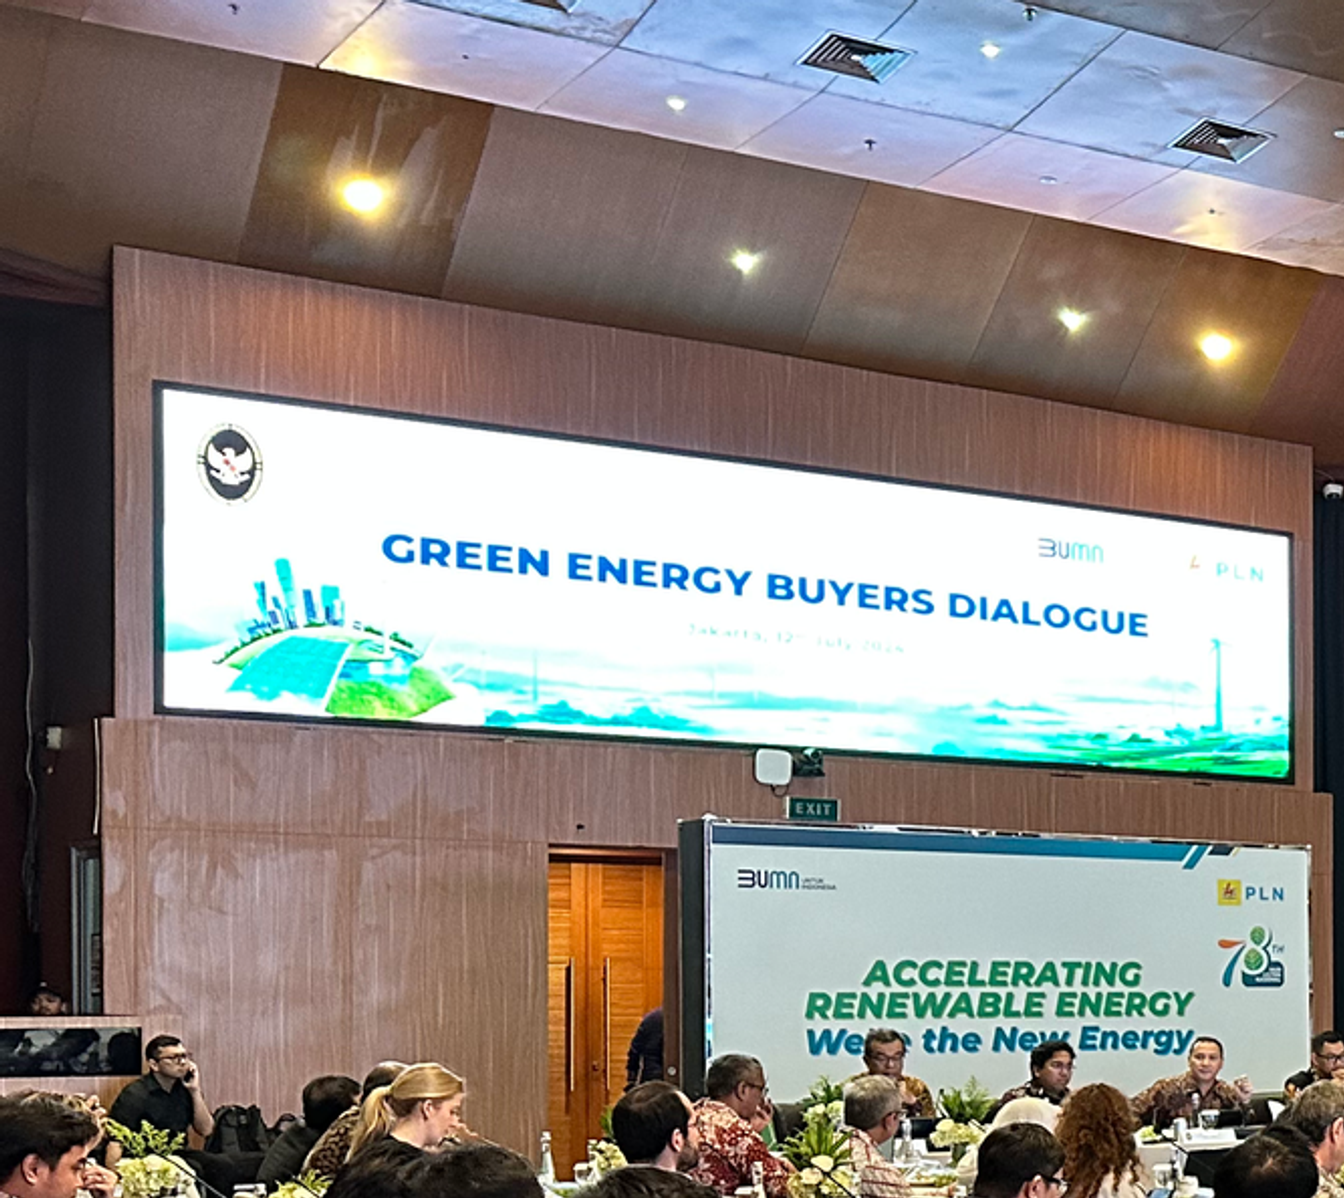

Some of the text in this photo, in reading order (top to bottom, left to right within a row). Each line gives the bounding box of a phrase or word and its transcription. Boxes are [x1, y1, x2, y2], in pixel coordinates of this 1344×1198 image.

[382, 533, 1149, 637] GREEN ENERGY BUYERS DIALOGUE
[1216, 562, 1264, 583] PLN
[795, 802, 832, 816] EXIT
[1245, 886, 1284, 901] PLN
[861, 959, 1143, 988] ACCELERATING
[804, 991, 1196, 1020] RENEWABLE ENERGY
[921, 1026, 983, 1054] the
[1078, 1026, 1195, 1056] Energy
